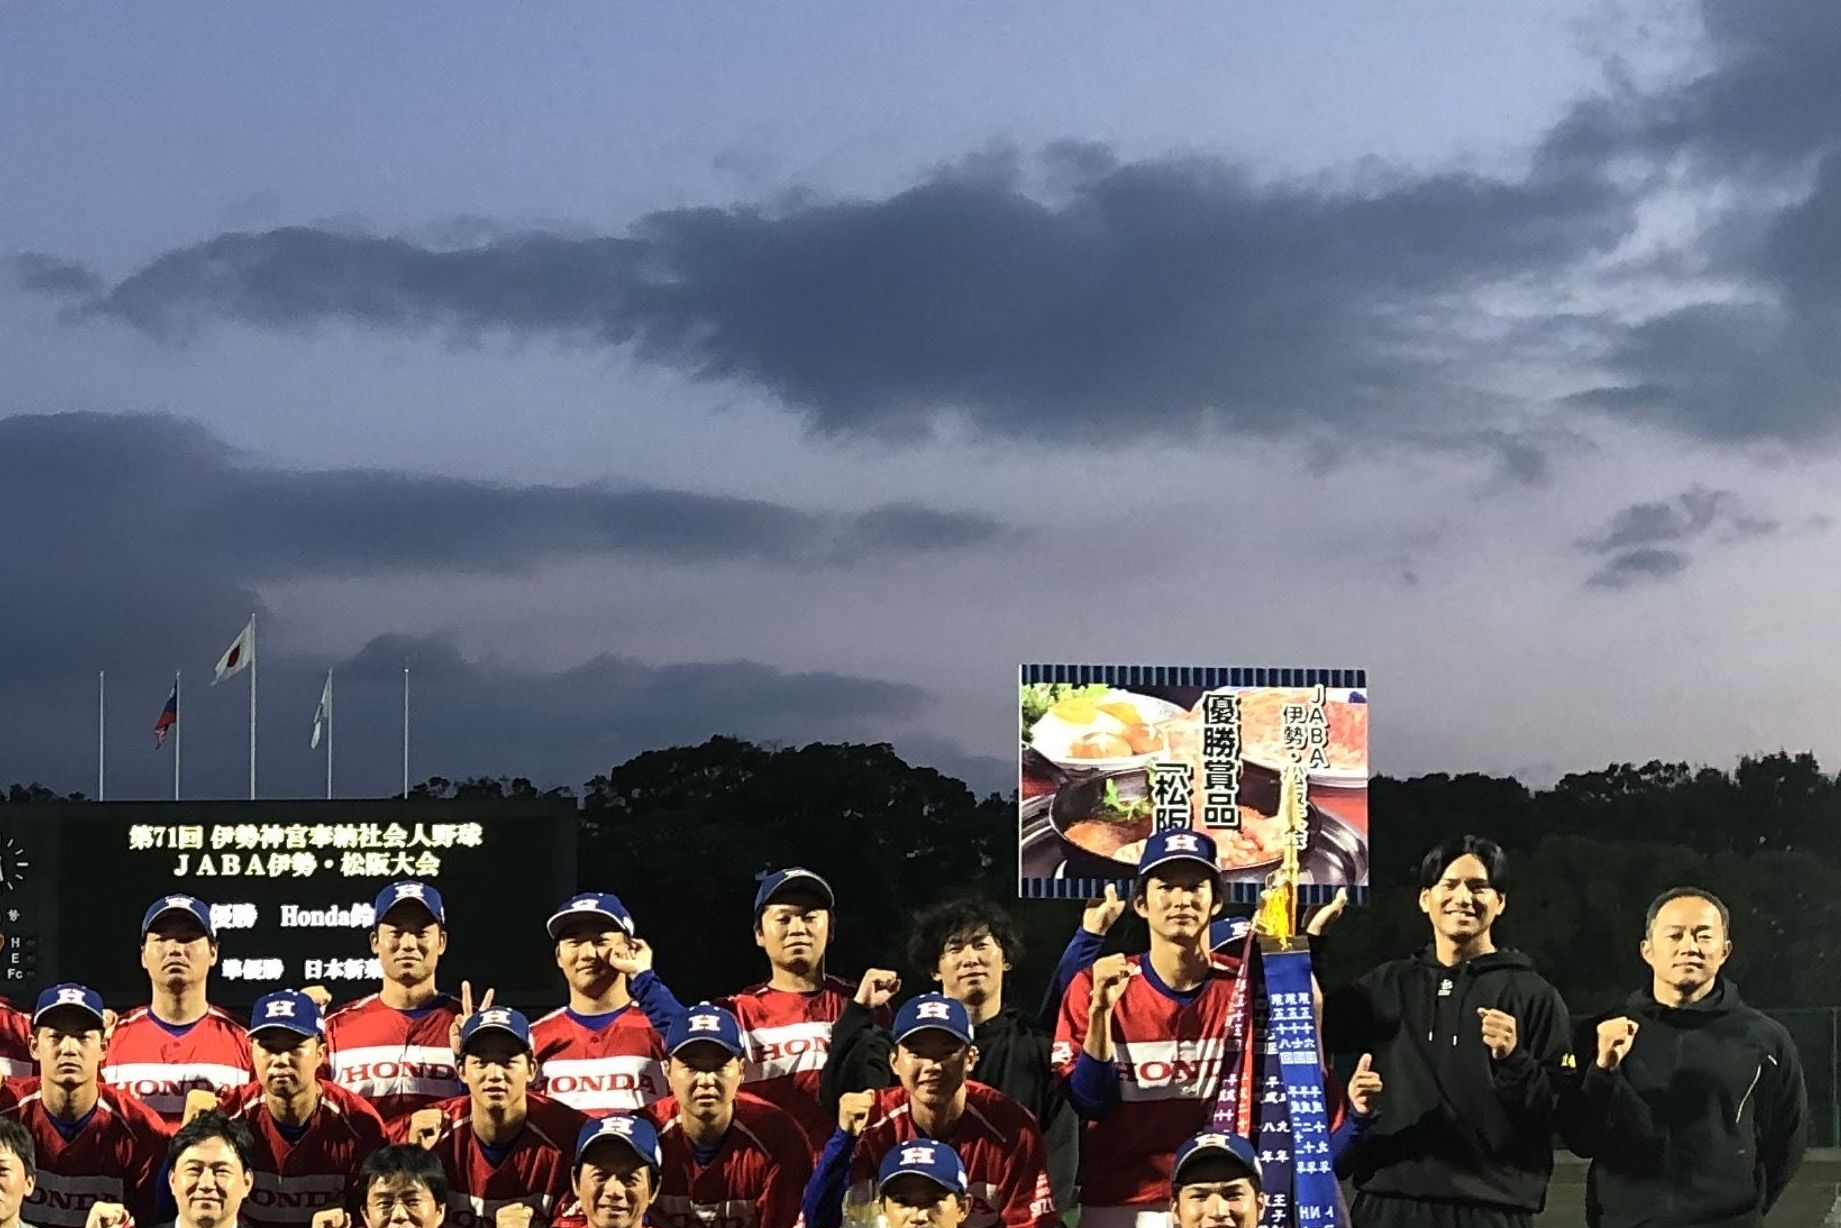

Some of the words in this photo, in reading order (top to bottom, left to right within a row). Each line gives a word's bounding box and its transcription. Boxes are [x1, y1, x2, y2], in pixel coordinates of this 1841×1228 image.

[1309, 686, 1326, 766] JABA
[1204, 693, 1240, 827] 優勝賞品
[129, 824, 203, 850] 第71回
[1165, 834, 1198, 851] H
[280, 903, 377, 928] Honda鈴
[10, 936, 21, 949] H
[11, 952, 20, 964] E
[57, 988, 85, 1005] H
[265, 1000, 295, 1018] H
[479, 1010, 511, 1025] H
[916, 1002, 950, 1019] H
[689, 1014, 720, 1032] H
[756, 1036, 831, 1064] HON
[343, 1061, 457, 1084] HOND
[1114, 1058, 1222, 1082] HON
[599, 1117, 634, 1134] H
[900, 1147, 935, 1165] H
